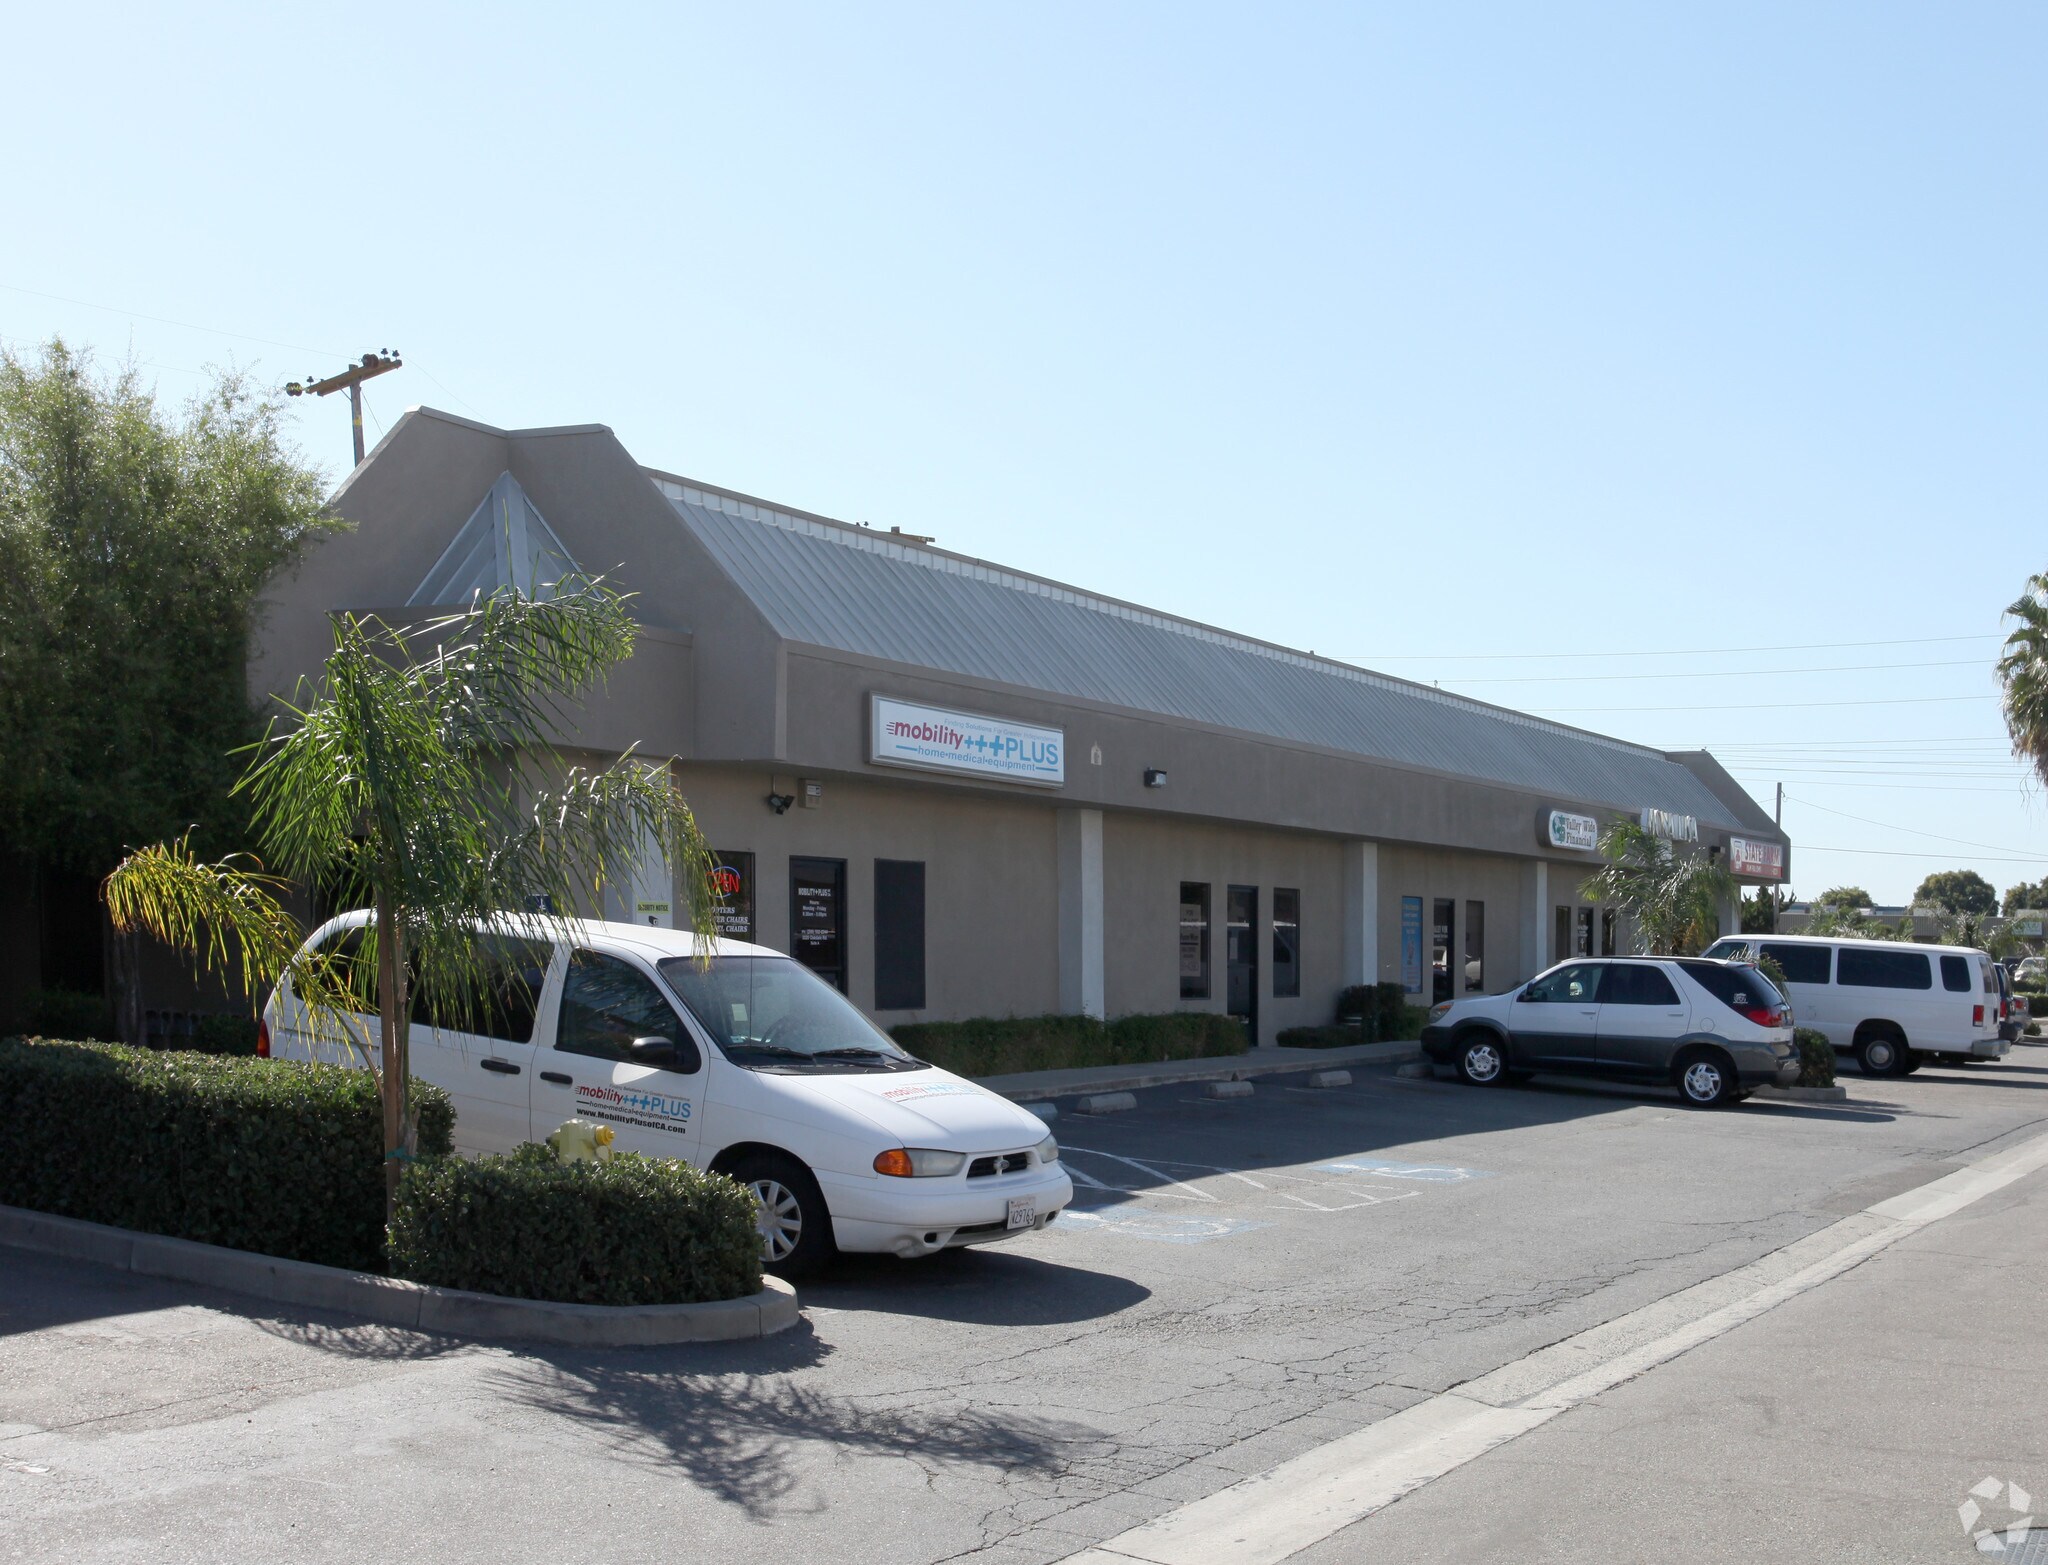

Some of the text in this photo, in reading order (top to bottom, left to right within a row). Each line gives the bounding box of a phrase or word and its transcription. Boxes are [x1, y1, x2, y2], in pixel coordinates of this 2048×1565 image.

[894, 721, 964, 750] mobility
[965, 722, 992, 733] Solutions
[1566, 831, 1592, 847] Financial
[705, 871, 740, 896] OPEN
[579, 1085, 623, 1105] mobility
